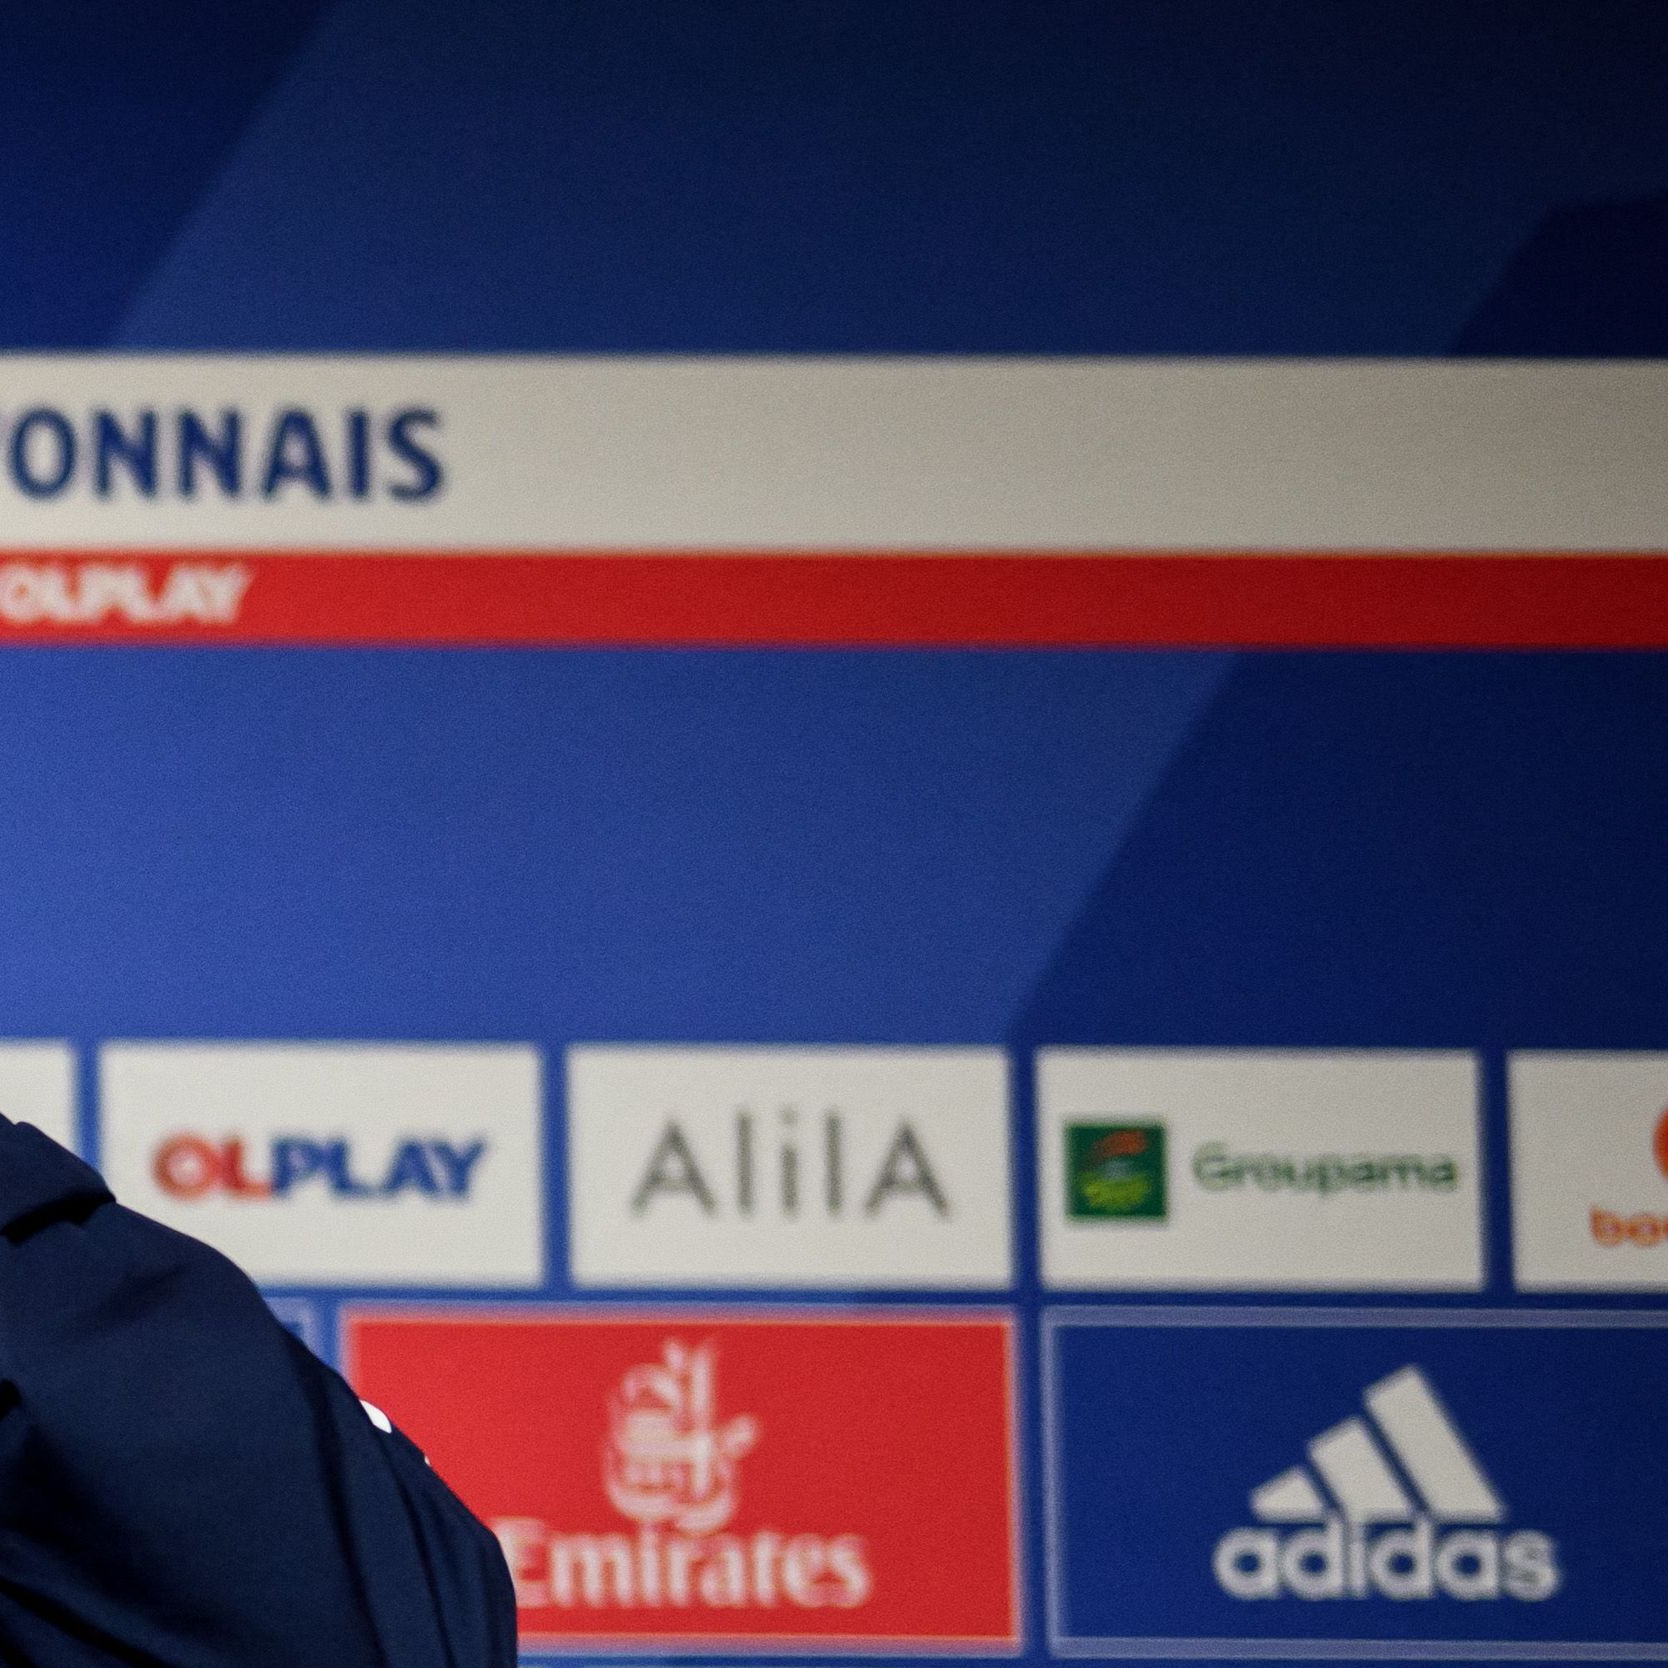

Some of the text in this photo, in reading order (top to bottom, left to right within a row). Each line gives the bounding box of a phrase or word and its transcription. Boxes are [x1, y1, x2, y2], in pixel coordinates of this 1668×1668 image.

[150, 1131, 488, 1203] OLPLAY
[1191, 1141, 1460, 1198] Groupama
[492, 1515, 873, 1611] Emirates
[1211, 1514, 1562, 1602] adidas
